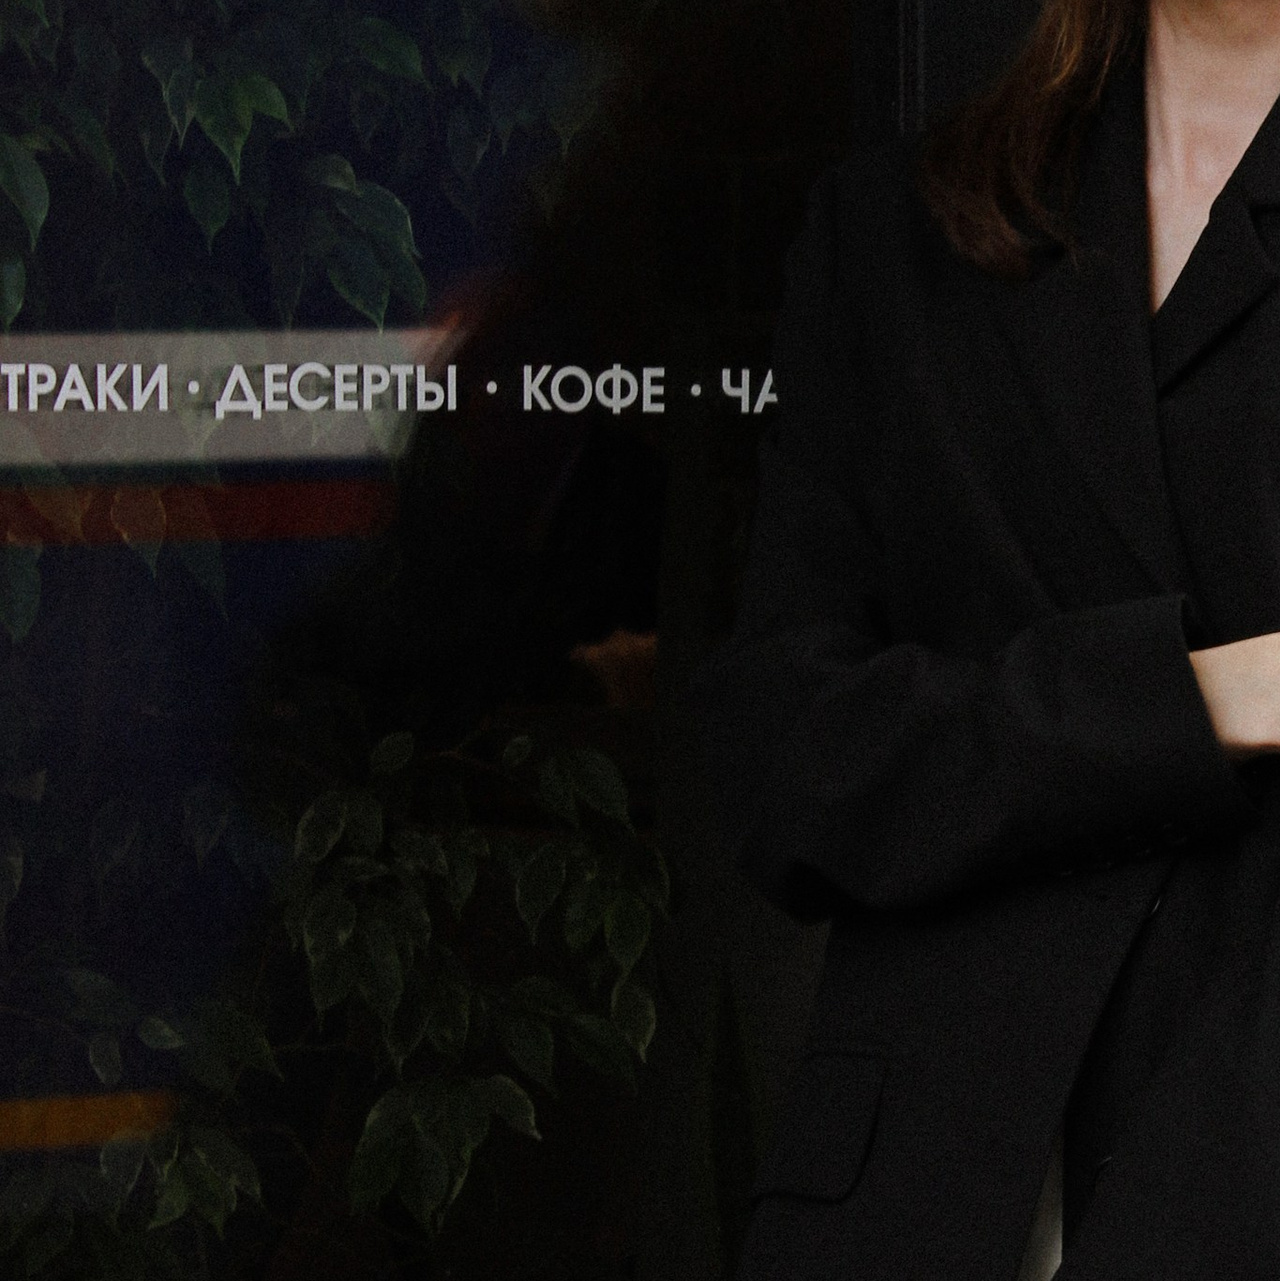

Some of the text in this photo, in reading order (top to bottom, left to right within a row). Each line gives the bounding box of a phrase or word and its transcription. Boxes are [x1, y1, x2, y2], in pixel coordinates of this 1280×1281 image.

[0, 362, 169, 412] ТРАКИ
[214, 361, 457, 420] ДЕСЕРТЫ
[522, 364, 665, 414] КОФЕ
